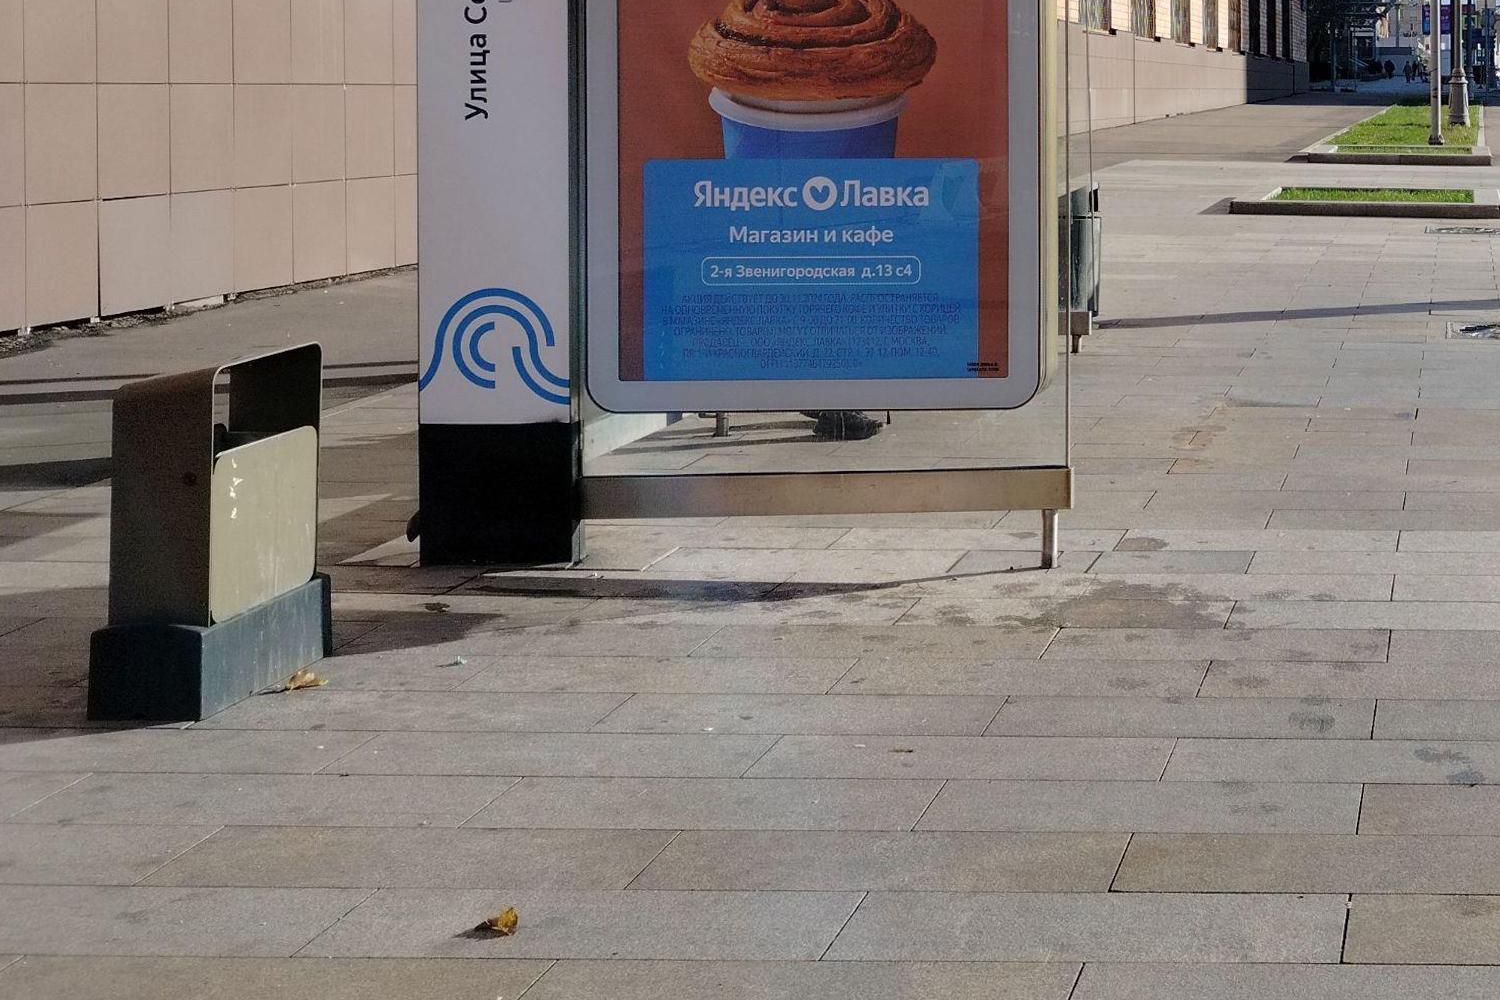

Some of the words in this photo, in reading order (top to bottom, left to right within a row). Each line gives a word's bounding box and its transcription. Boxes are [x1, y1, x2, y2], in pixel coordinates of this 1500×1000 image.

[464, 33, 490, 120] Улица
[693, 180, 798, 212] Яндекс
[840, 180, 930, 208] Лавка
[729, 226, 818, 244] Магазин
[824, 230, 837, 243] и
[842, 226, 894, 248] кафе
[710, 265, 733, 278] 2-я
[736, 264, 855, 281] Звенигородская
[895, 265, 913, 278] с4
